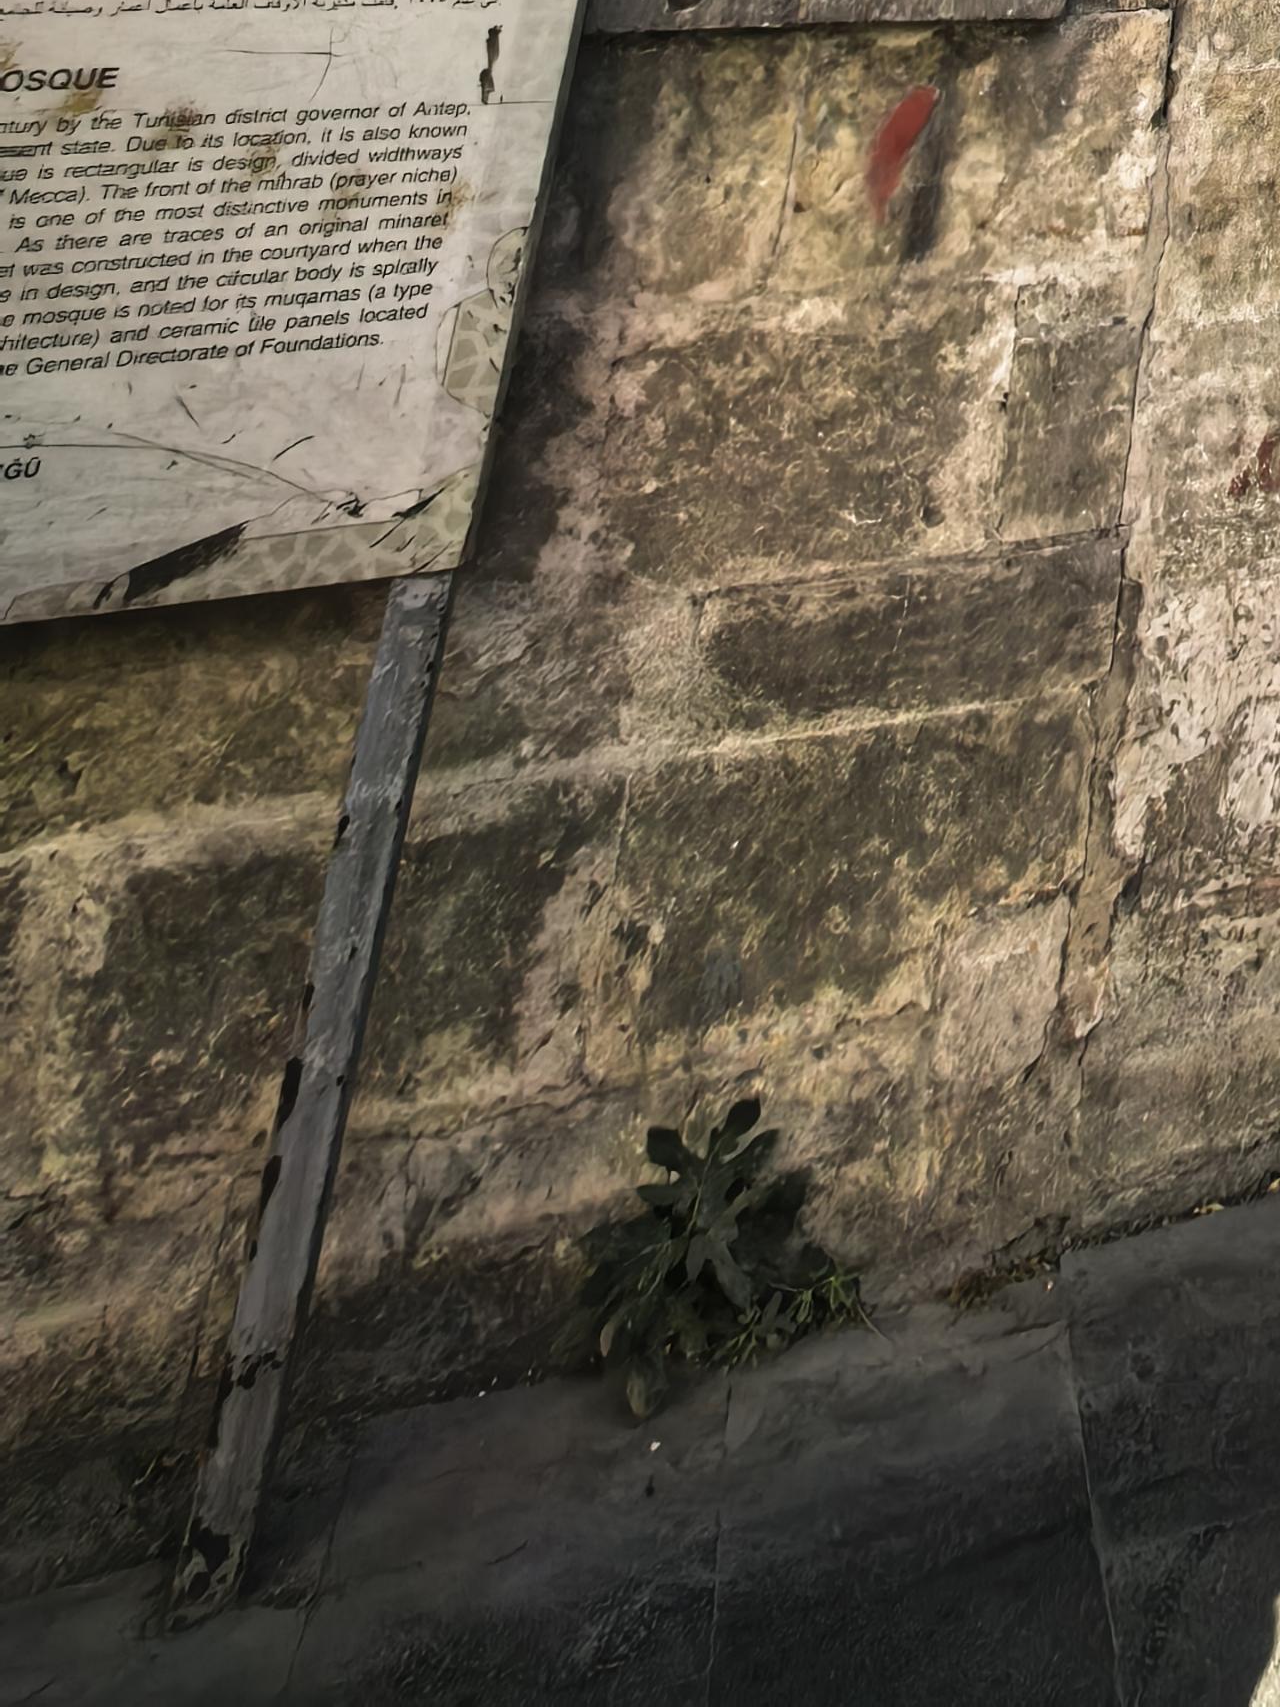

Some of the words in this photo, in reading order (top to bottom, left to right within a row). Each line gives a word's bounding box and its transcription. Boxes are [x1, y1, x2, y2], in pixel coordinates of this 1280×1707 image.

[56, 116, 81, 136] by
[90, 114, 122, 130] the
[226, 108, 288, 125] district
[296, 107, 380, 125] governor
[388, 102, 407, 118] of
[126, 136, 166, 152] Due
[175, 134, 194, 150] to
[200, 132, 224, 148] its
[321, 128, 332, 143] it
[339, 127, 354, 142] is
[362, 125, 402, 141] also
[408, 123, 467, 139] known
[37, 164, 54, 180] is
[63, 157, 179, 180] rectangular
[187, 158, 204, 172] is
[291, 149, 360, 167] divided
[368, 144, 464, 164] widthways
[101, 183, 140, 200] The
[144, 180, 190, 198] front
[195, 178, 217, 195] of
[220, 178, 252, 193] the
[330, 171, 397, 192] (prayer
[9, 214, 26, 230] is
[35, 213, 75, 229] one
[85, 208, 107, 225] of
[114, 207, 146, 224] the
[155, 205, 205, 221] most
[213, 198, 309, 216] distinctive
[318, 191, 428, 212] monuments
[436, 188, 453, 205] in
[14, 237, 44, 254] As
[55, 232, 109, 250] there
[118, 232, 153, 247] are
[163, 227, 225, 244] traces
[235, 222, 255, 239] of
[264, 224, 288, 237] an
[299, 217, 369, 238] original
[378, 212, 449, 232] minaret
[23, 262, 64, 277] was
[71, 251, 193, 273] constructed
[197, 250, 215, 265] in
[223, 246, 253, 264] the
[260, 240, 351, 263] courtyard
[358, 238, 408, 254] when
[415, 235, 443, 251] the
[20, 287, 38, 302] in
[130, 277, 170, 293] and
[177, 275, 209, 289] the
[295, 266, 343, 285] body
[349, 262, 365, 278] is
[22, 307, 106, 328] mosque
[113, 303, 130, 319] is
[137, 298, 195, 319] noted
[202, 295, 228, 312] for
[235, 293, 257, 311] its
[393, 282, 433, 301] type
[110, 327, 149, 344] and
[157, 319, 240, 340] ceramic
[284, 311, 350, 333] panels
[359, 303, 429, 323] located
[26, 352, 110, 375] General
[116, 343, 228, 365] Directorate
[235, 339, 256, 356] of
[259, 334, 384, 354] Foundations.
